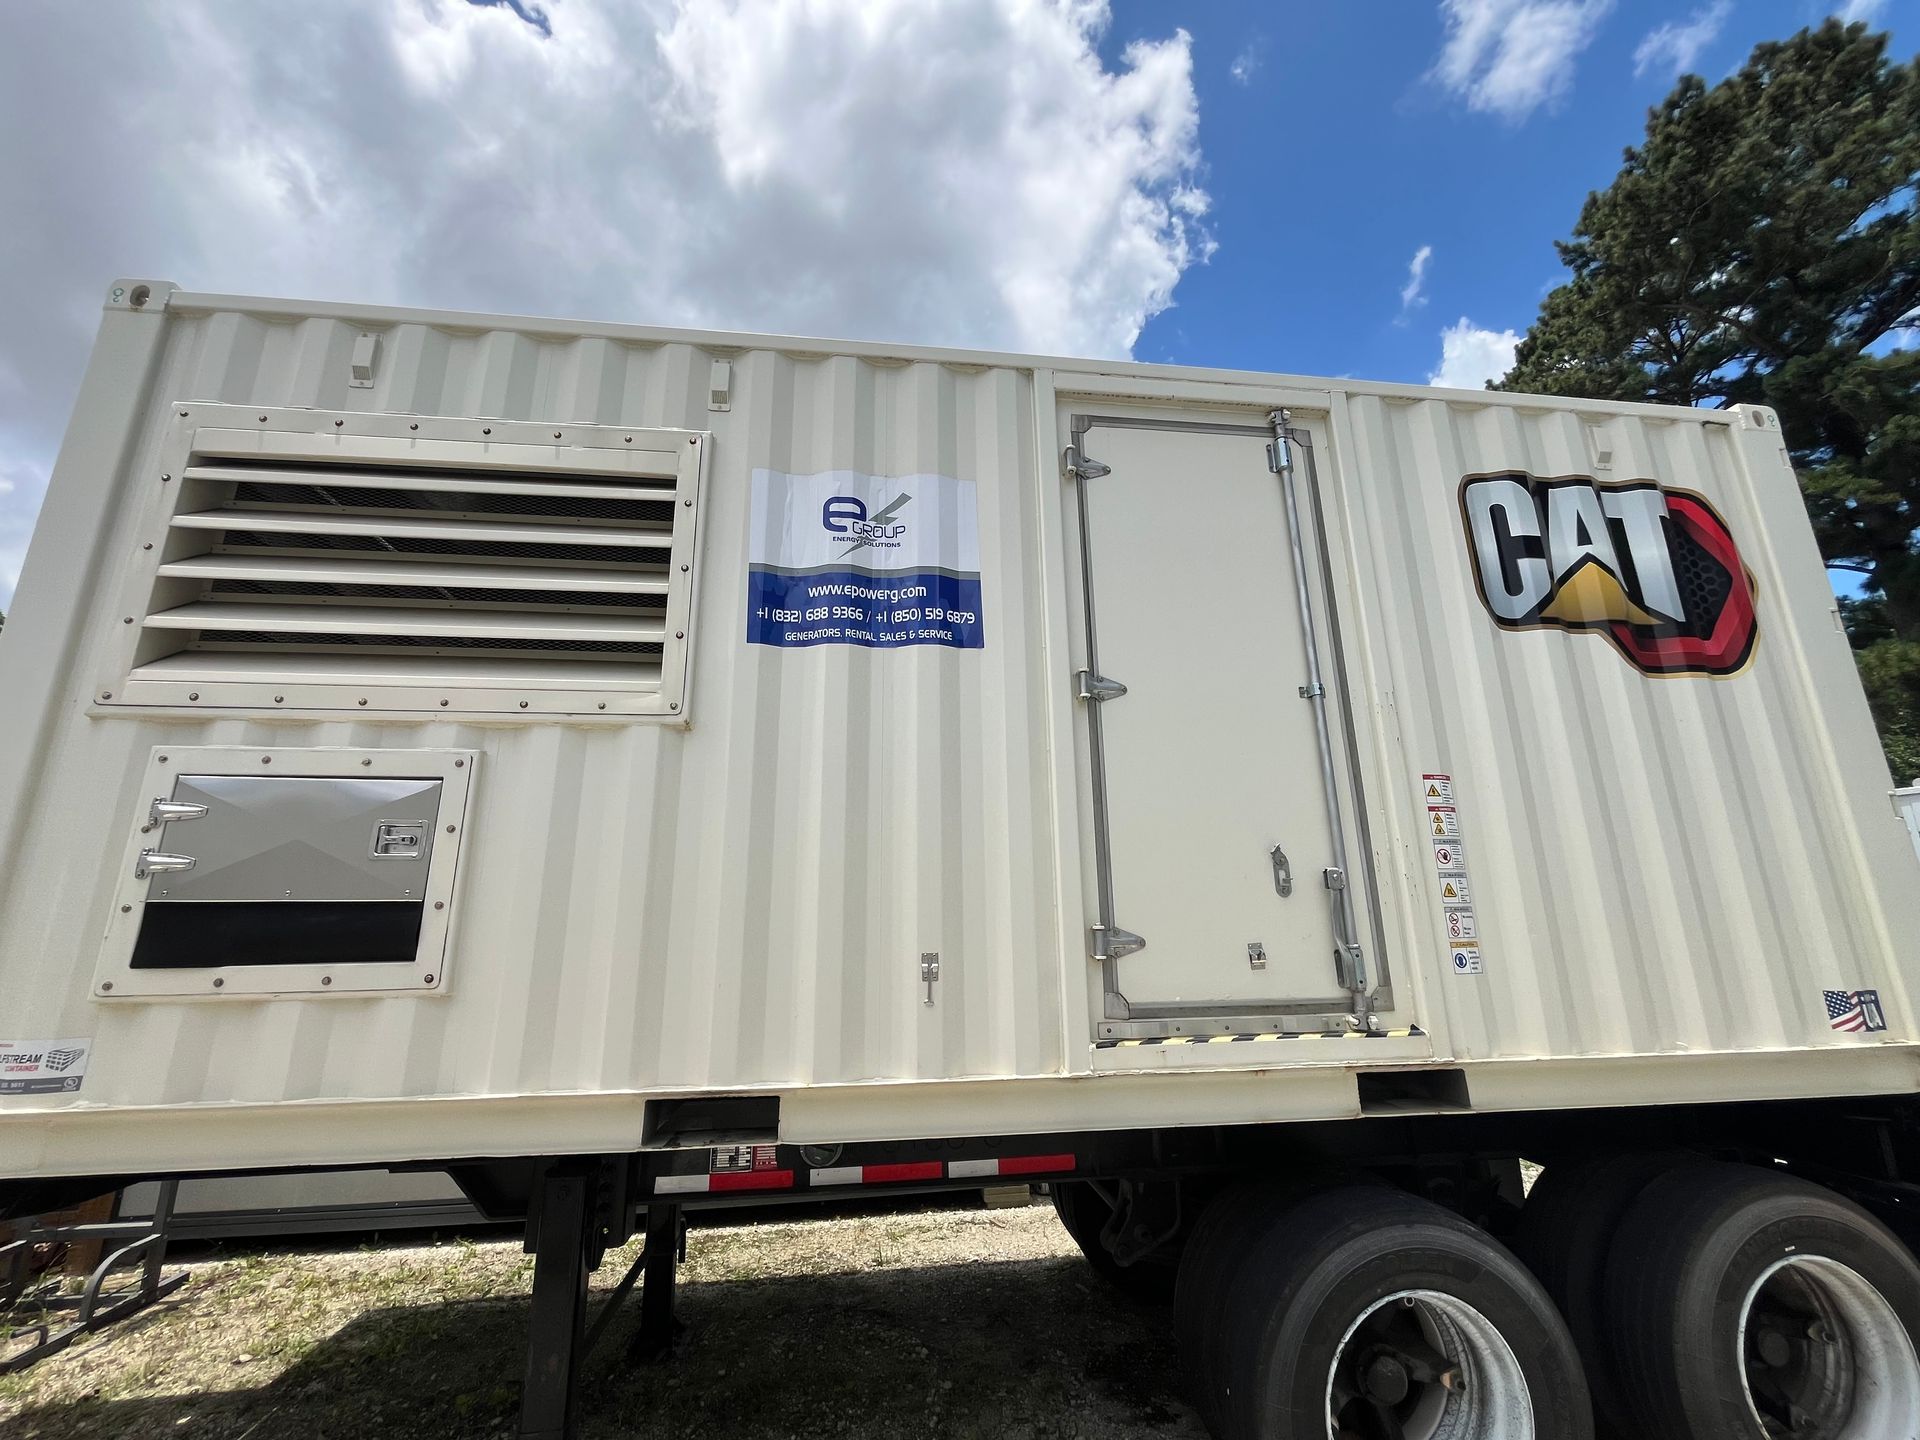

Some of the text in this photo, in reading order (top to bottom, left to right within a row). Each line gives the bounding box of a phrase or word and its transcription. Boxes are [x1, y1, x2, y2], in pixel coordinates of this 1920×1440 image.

[852, 521, 906, 539] GROUP
[863, 540, 901, 548] SOLUTIONS
[1466, 480, 1686, 622] CAT
[808, 585, 927, 603] www.epowerg.com
[756, 607, 768, 619] +1
[772, 609, 802, 623] (832)
[806, 607, 828, 621] 688
[832, 606, 863, 620] 9366
[875, 611, 887, 623] +1
[891, 608, 921, 624] (850)
[925, 608, 943, 620] 519
[946, 610, 975, 624] 6879
[879, 631, 907, 641] SALES
[909, 630, 915, 639] &
[918, 630, 952, 640] SERVICE
